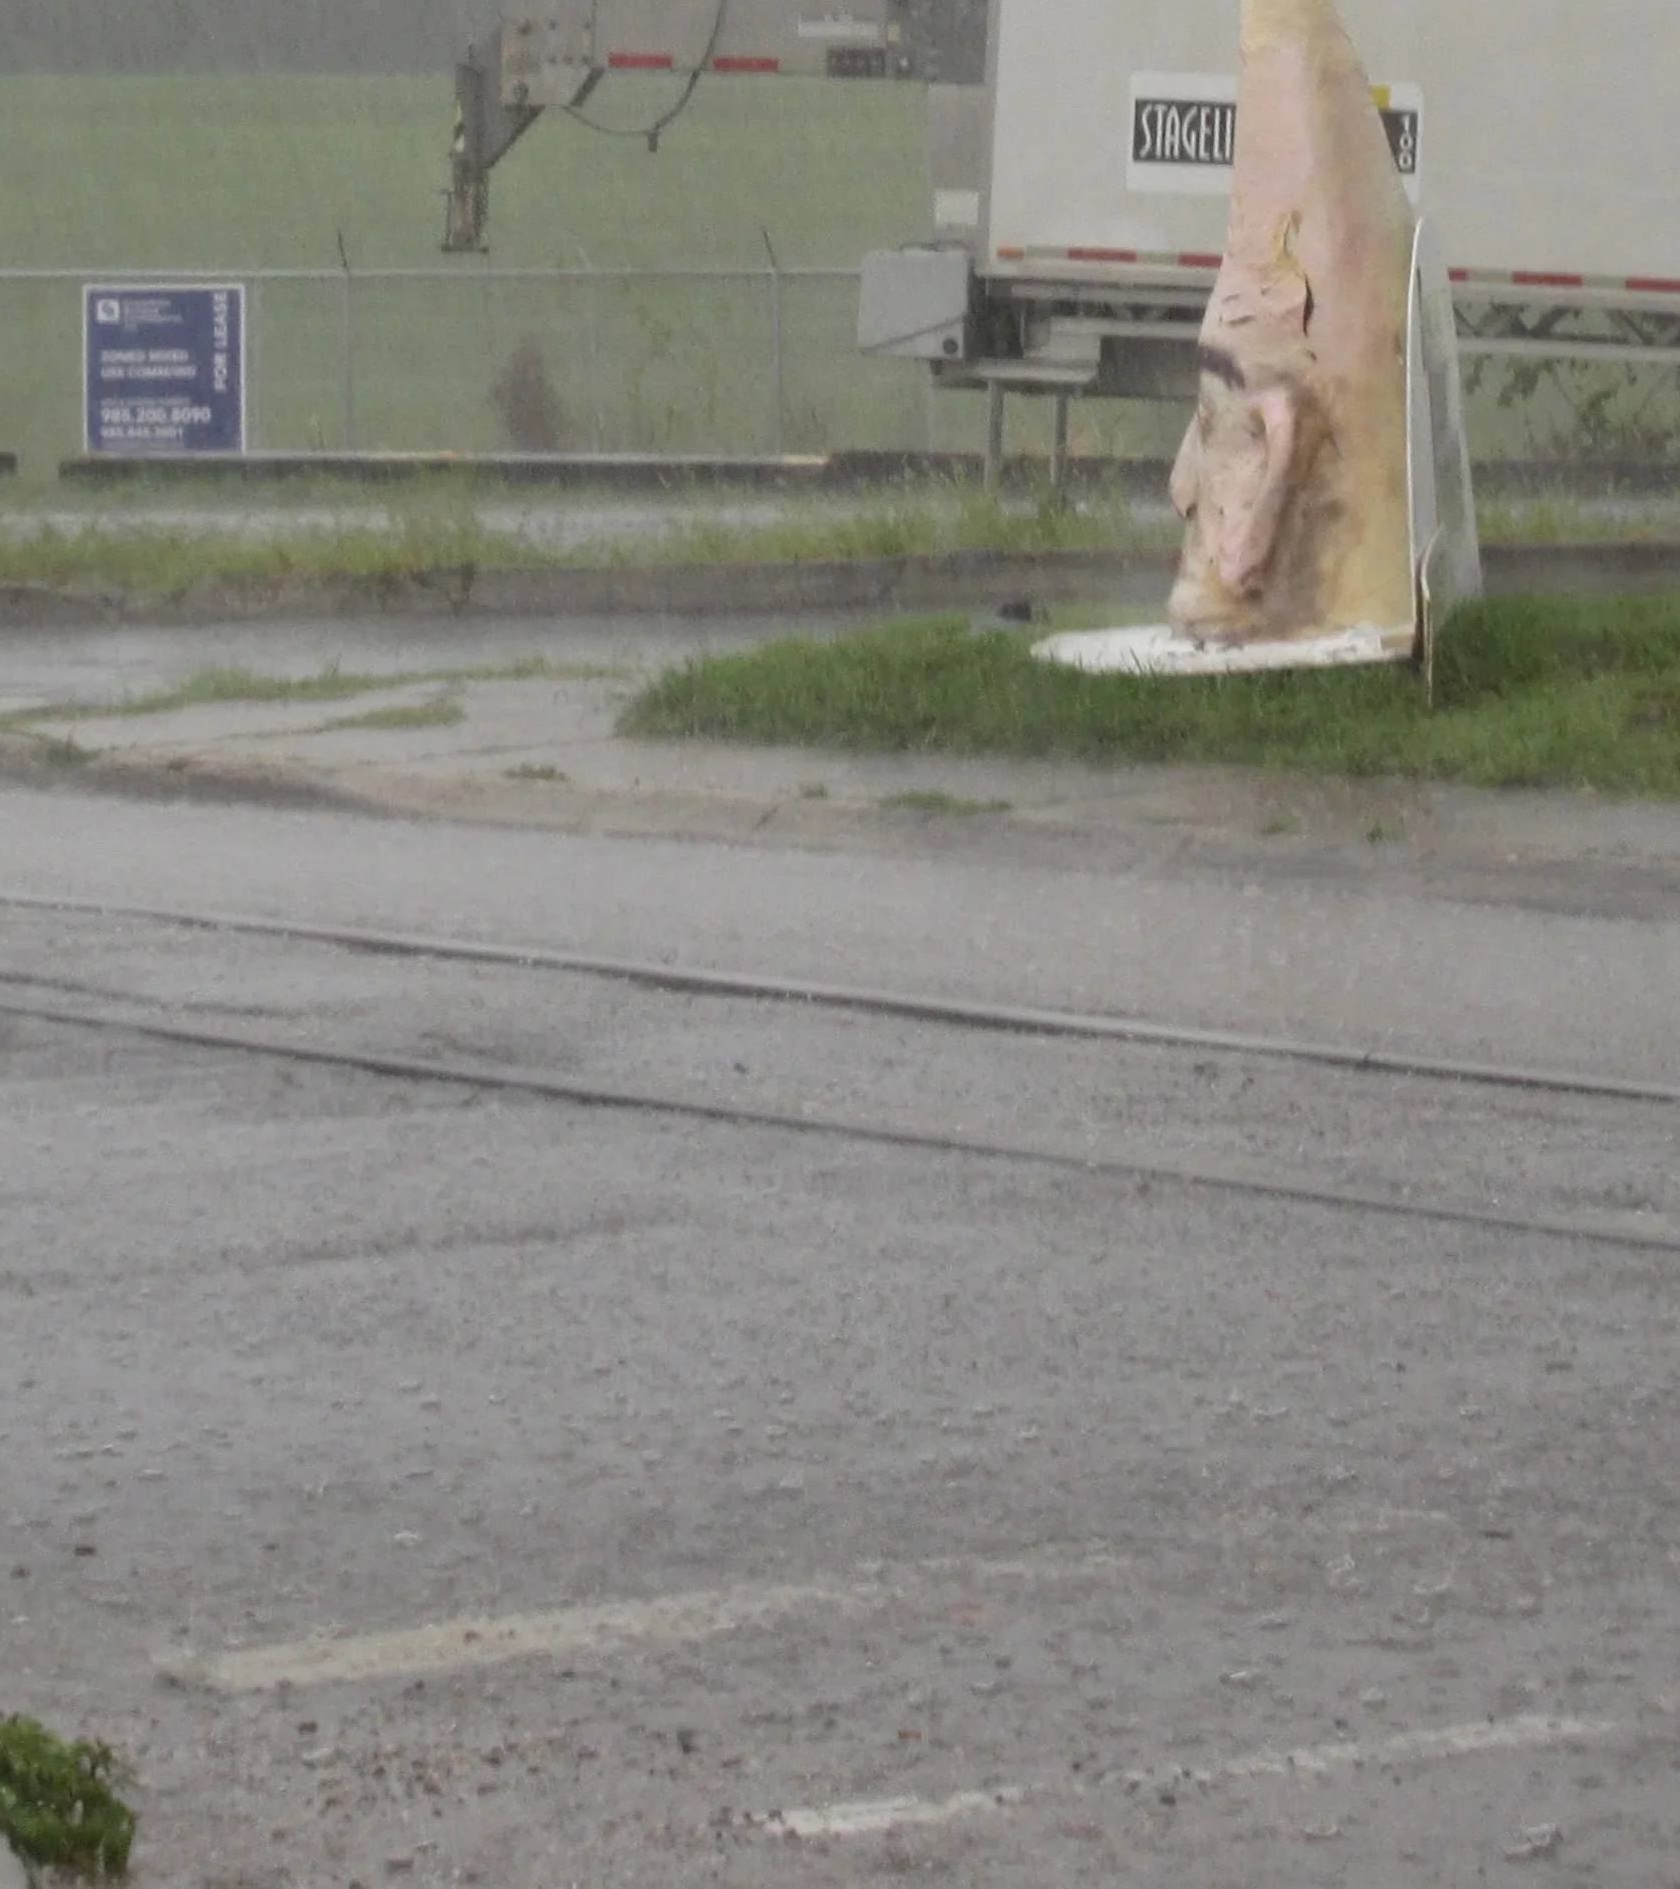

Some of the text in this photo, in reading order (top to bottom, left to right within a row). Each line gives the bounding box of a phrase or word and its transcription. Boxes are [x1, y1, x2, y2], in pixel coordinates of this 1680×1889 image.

[1137, 102, 1233, 161] STAGELI
[214, 291, 228, 393] FOR LEASE
